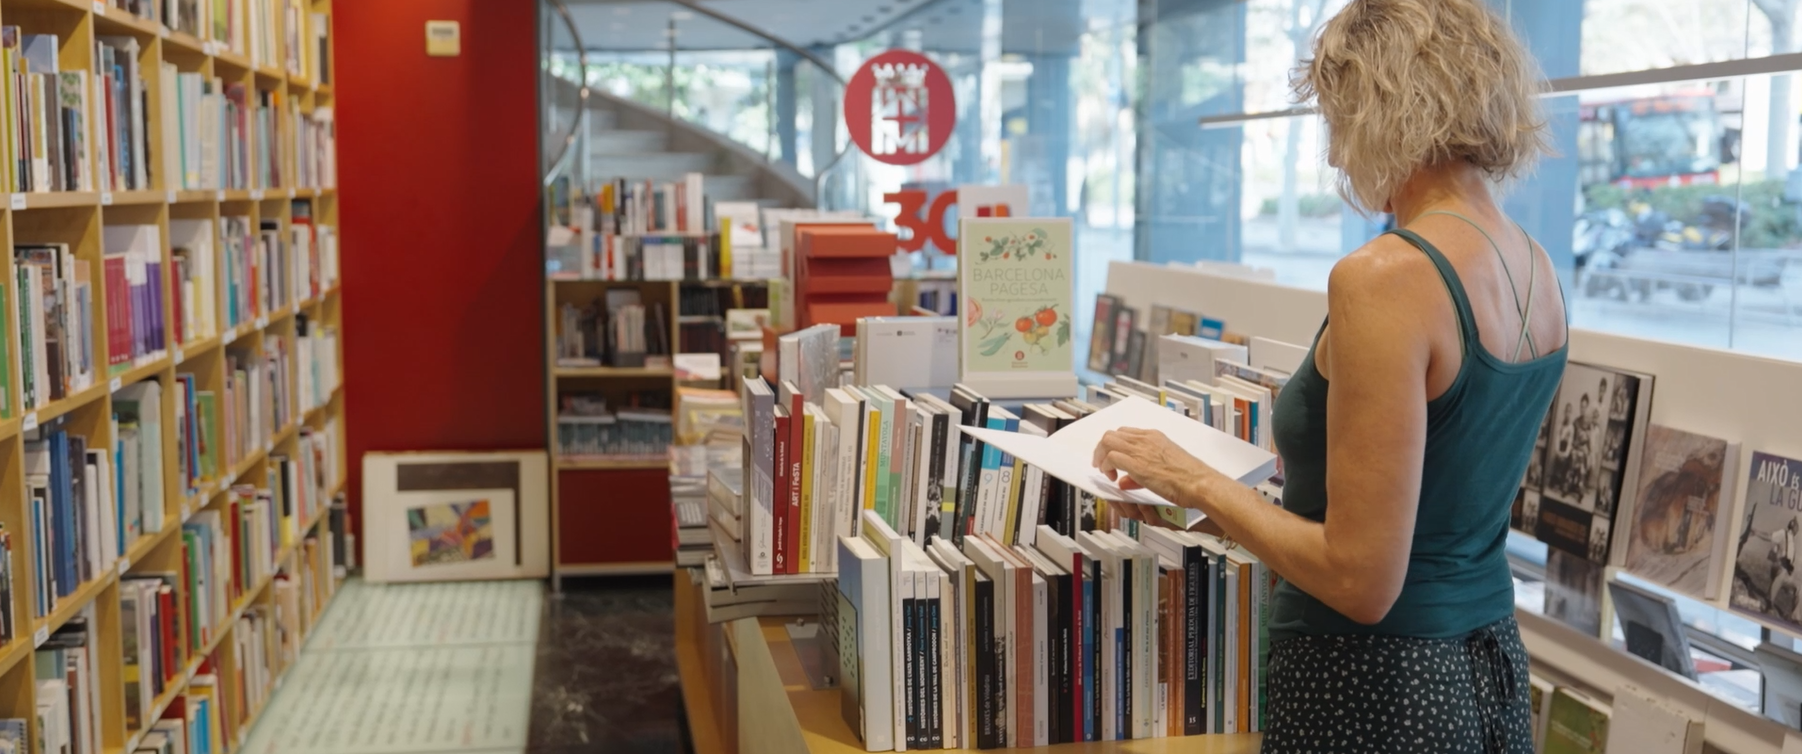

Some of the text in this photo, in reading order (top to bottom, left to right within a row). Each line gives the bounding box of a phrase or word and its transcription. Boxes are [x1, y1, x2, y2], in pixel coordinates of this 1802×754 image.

[973, 268, 1065, 282] BARCELONA
[990, 282, 1048, 296] PAGESA
[1757, 460, 1788, 486] AIXÒ
[1770, 486, 1784, 507] LA
[1188, 597, 1195, 606] DE
[907, 678, 912, 686] DE
